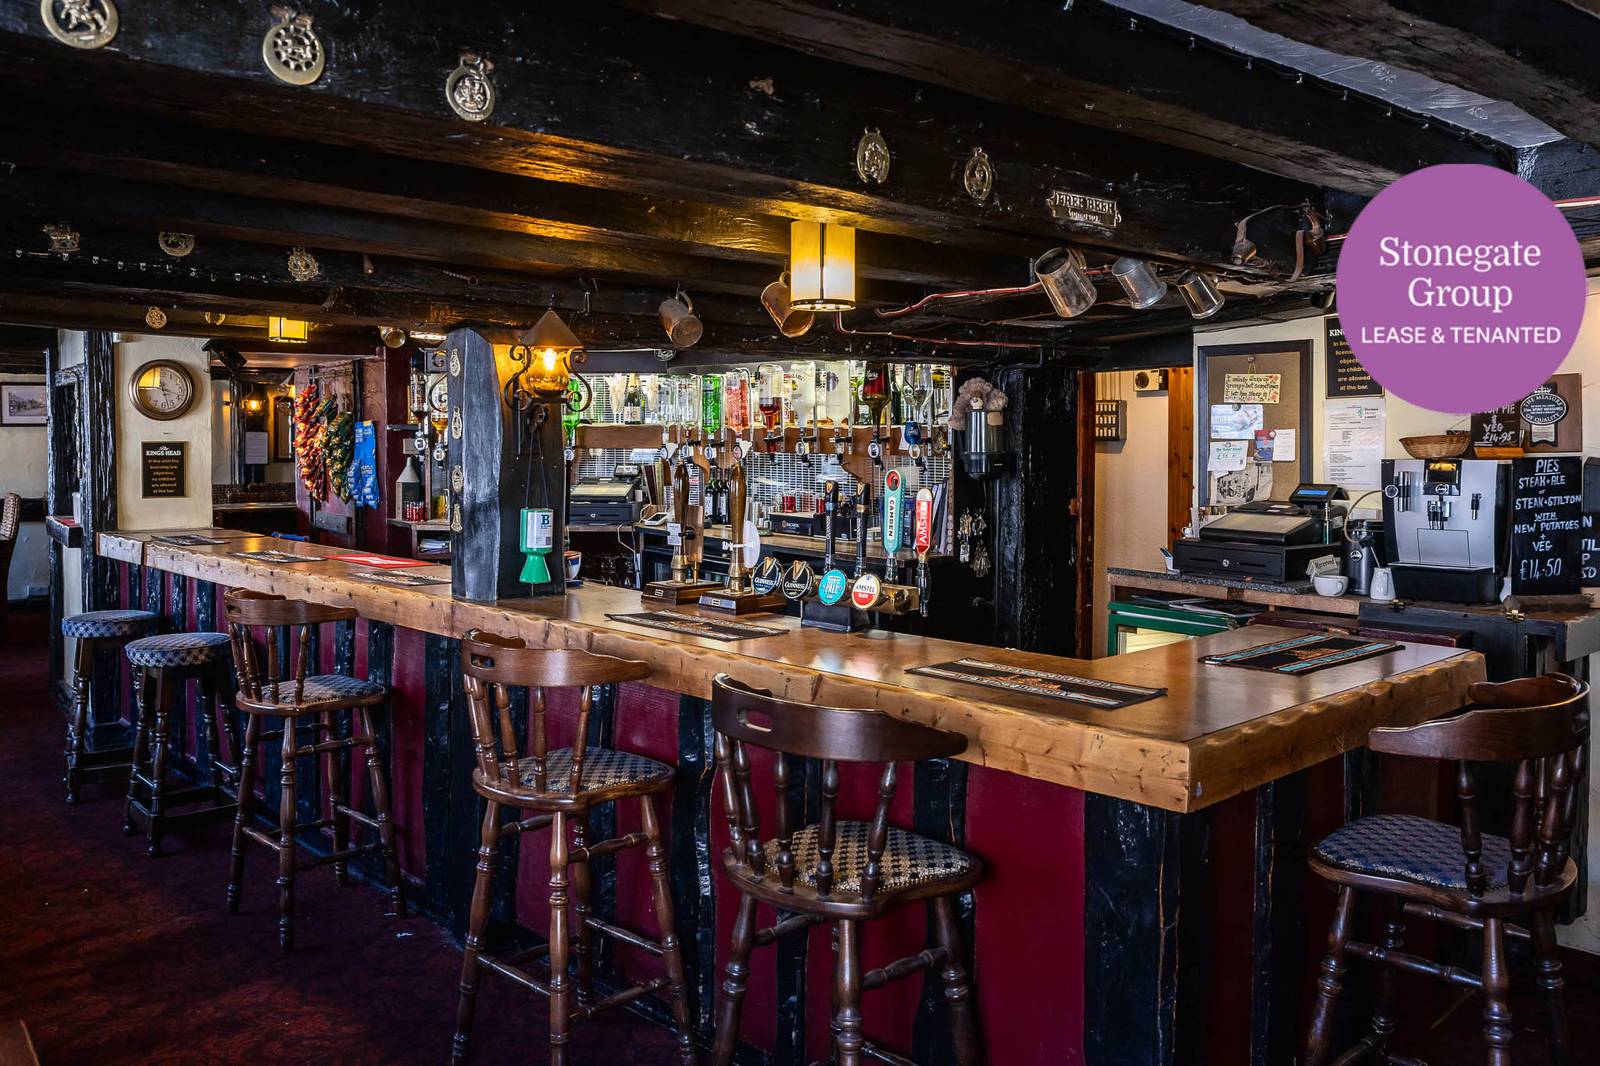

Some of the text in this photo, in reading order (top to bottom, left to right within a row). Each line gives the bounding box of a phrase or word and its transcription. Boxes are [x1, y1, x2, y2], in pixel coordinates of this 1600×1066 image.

[1056, 192, 1114, 214] FREE BEER
[1329, 329, 1345, 337] KIN
[1536, 394, 1563, 406] MEASURE
[1534, 412, 1560, 423] QUALITY
[1536, 459, 1560, 473] PIES
[1535, 512, 1557, 521] WITH
[1514, 520, 1580, 534] NEW POTATOES
[1532, 541, 1553, 552] VEG
[754, 576, 775, 586] GUINNESS
[784, 581, 806, 590] GUINNESS
